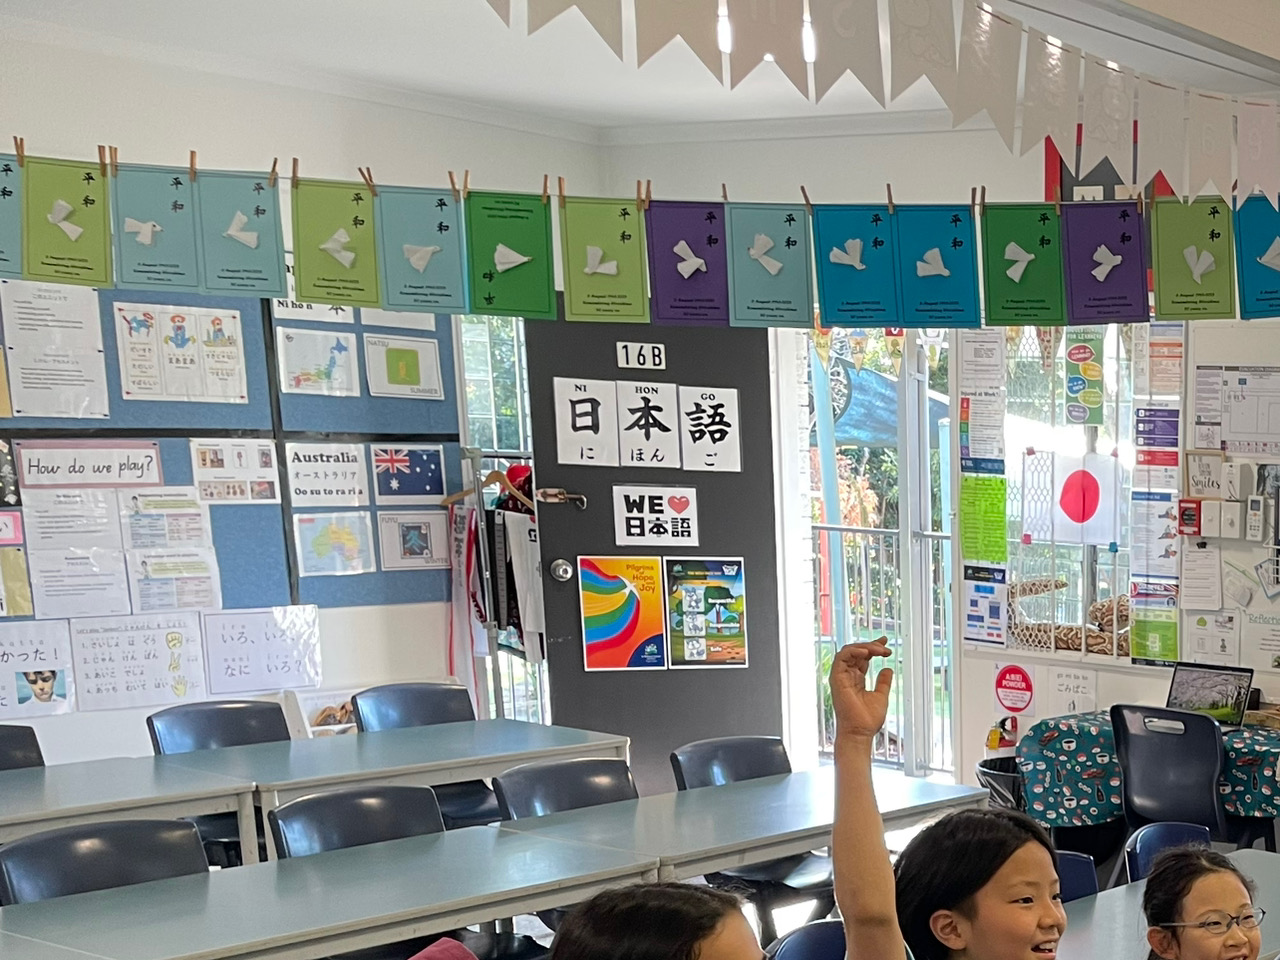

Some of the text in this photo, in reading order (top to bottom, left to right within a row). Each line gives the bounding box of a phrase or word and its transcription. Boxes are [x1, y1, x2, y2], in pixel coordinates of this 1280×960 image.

[367, 338, 389, 348] NATSU
[622, 344, 662, 367] 16B
[410, 387, 438, 395] SUMMER
[574, 384, 716, 401] NI HON GO
[292, 451, 358, 463] Australia
[28, 455, 153, 478] How do we play?
[294, 471, 357, 480] オーストラリア
[295, 487, 308, 496] Oo
[310, 488, 321, 496] su
[323, 488, 334, 496] to
[336, 488, 346, 496] ra
[623, 494, 665, 514] WE
[625, 516, 691, 538] 日本語
[626, 564, 654, 572] Pilgrims
[633, 574, 654, 582] Hope
[639, 584, 656, 594] Joy
[225, 664, 250, 677] なに
[1002, 680, 1026, 689] POWDER
[1057, 683, 1088, 694] ごみばこ
